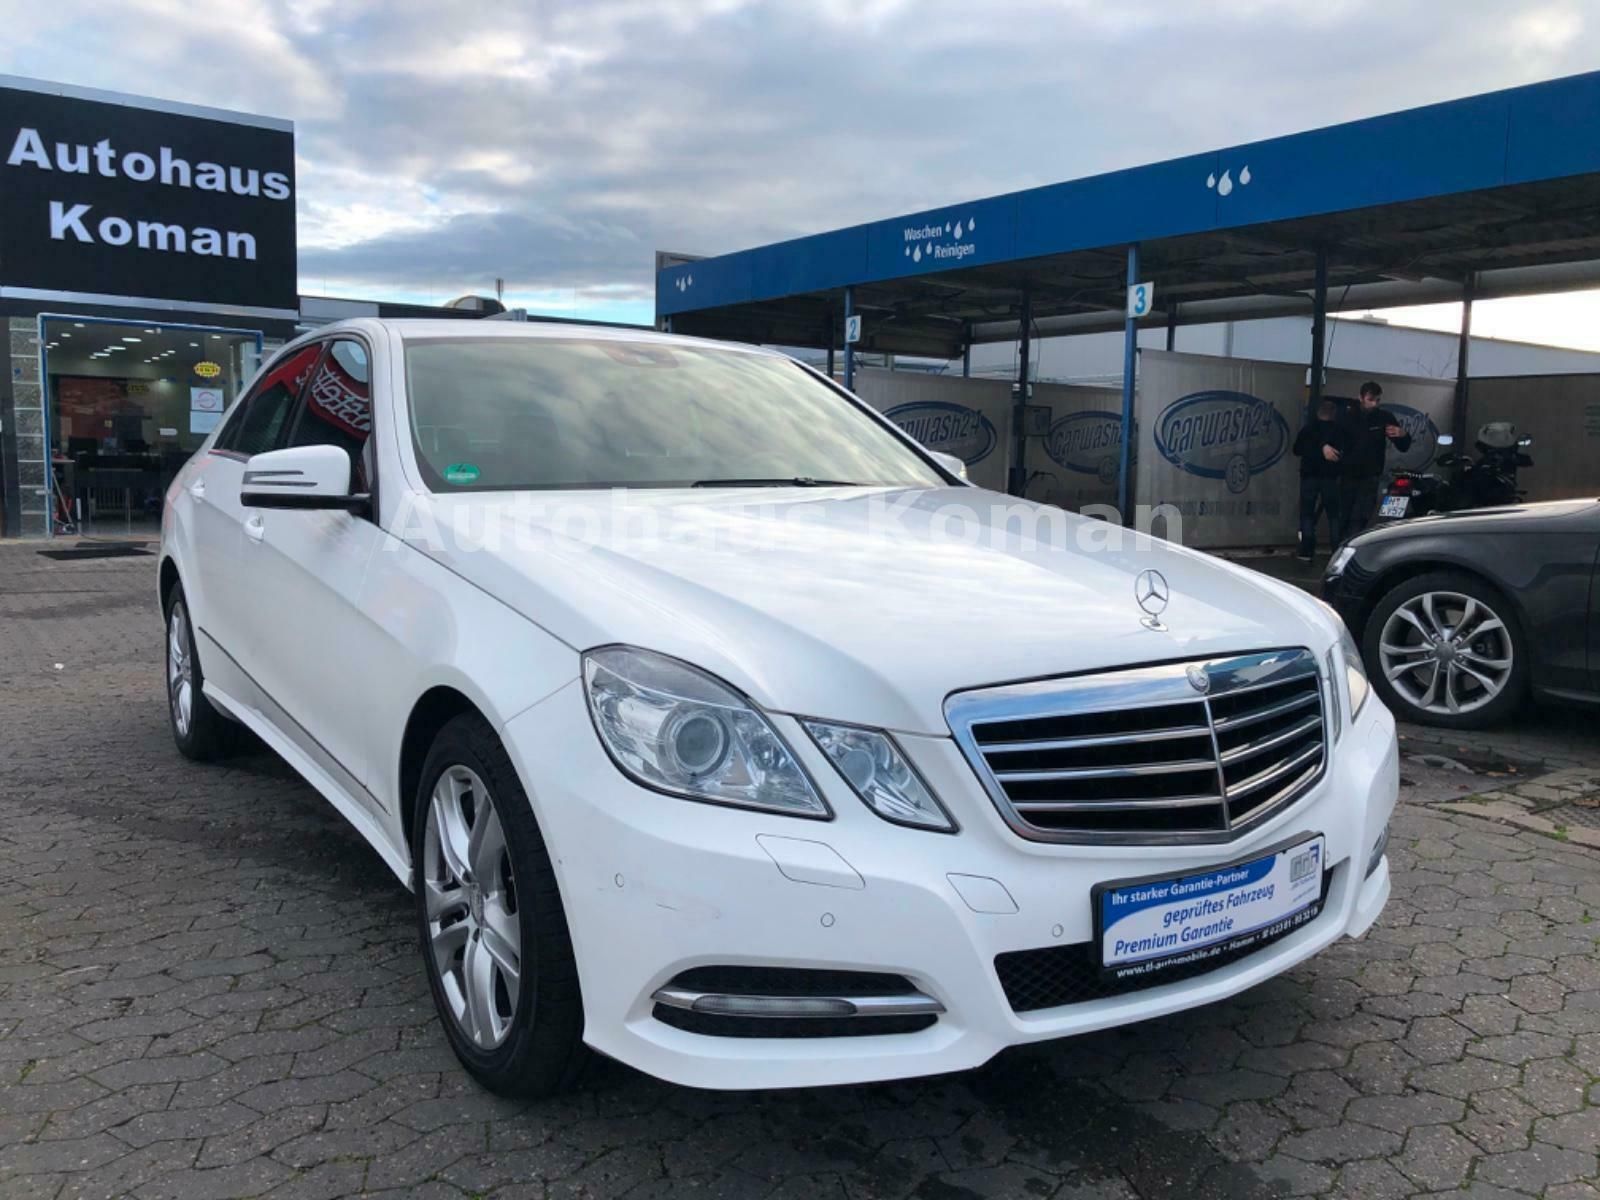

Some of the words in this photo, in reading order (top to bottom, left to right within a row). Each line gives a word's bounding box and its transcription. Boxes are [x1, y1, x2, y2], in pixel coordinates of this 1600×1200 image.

[6, 127, 291, 200] Autohaus
[49, 200, 257, 260] Koman
[904, 224, 942, 241] Waschen
[934, 242, 975, 259] Reinigen
[1134, 286, 1147, 314] 3
[849, 319, 858, 341] 2
[1112, 891, 1128, 905] Ihr
[1130, 887, 1172, 903] starker
[1170, 869, 1249, 896] Garantie-Partner
[1163, 899, 1224, 928] geprüftes
[1226, 883, 1275, 909] Fahrzeug
[1114, 933, 1177, 956] Premium
[1180, 916, 1234, 942] Garantie
